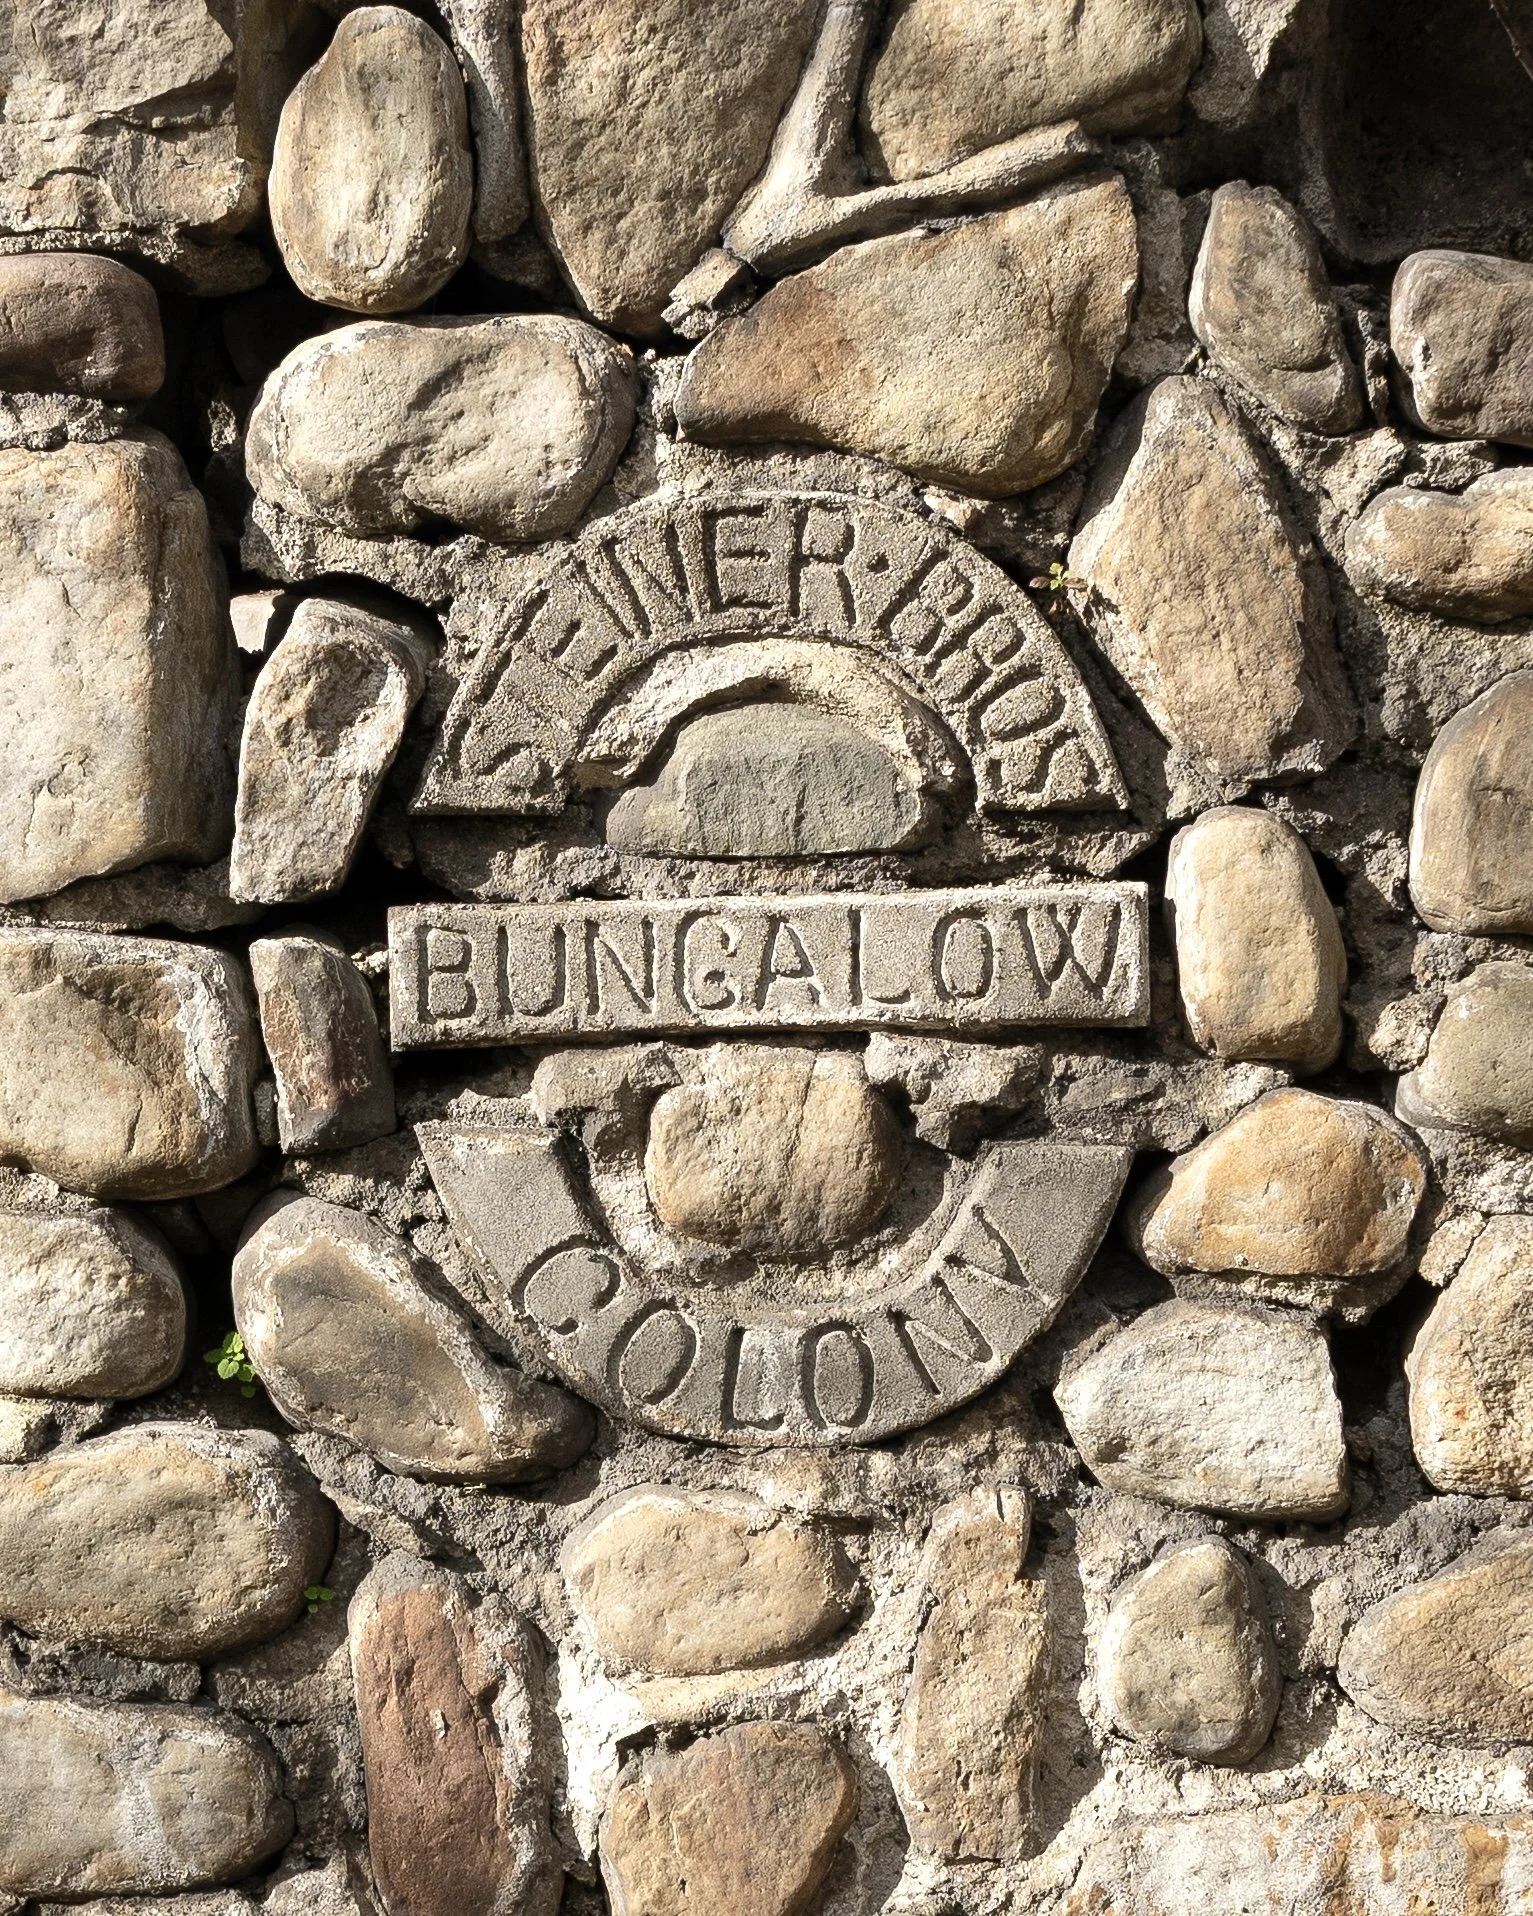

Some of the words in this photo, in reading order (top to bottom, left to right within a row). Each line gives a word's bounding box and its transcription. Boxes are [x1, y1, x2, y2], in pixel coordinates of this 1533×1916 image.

[446, 499, 858, 796] STEINER
[876, 538, 1100, 796] BROS
[416, 903, 1122, 1023] BUNGALOW
[510, 1206, 1053, 1430] COLONY
